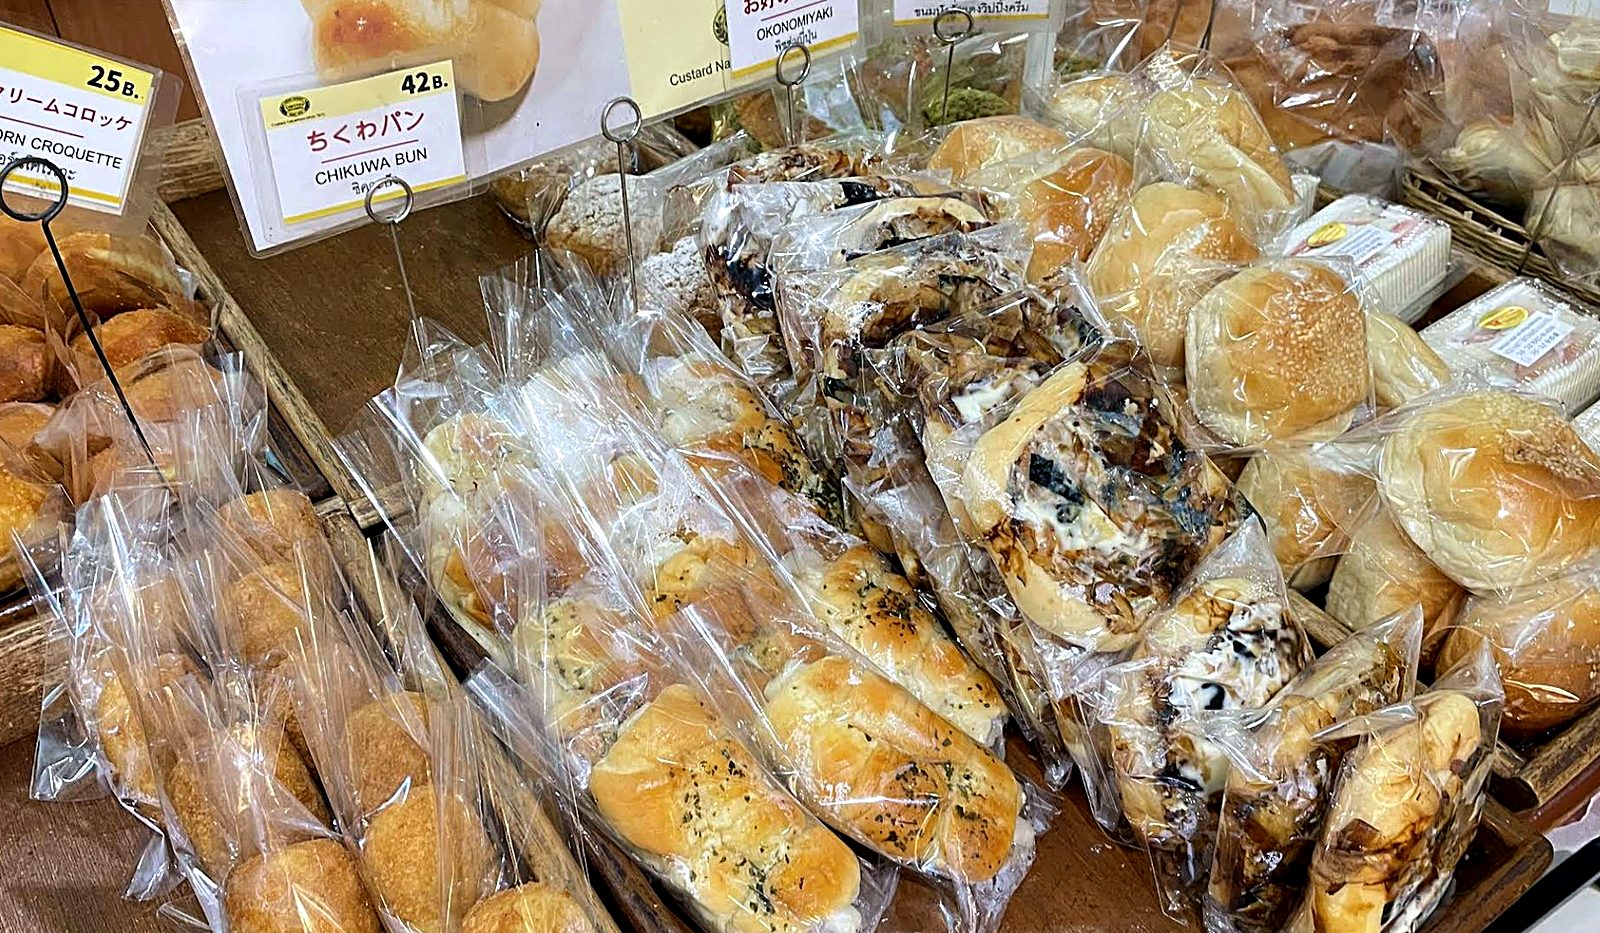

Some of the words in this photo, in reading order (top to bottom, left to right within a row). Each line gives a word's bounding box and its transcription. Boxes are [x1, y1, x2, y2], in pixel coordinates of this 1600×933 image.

[756, 6, 833, 41] OKONOMIYAKI
[669, 63, 712, 86] Custard
[0, 86, 133, 131] リームコロッケ
[307, 110, 424, 152] ちくわパン
[31, 137, 123, 169] CROQUETTE
[315, 156, 391, 186] CHIKUWA
[395, 148, 428, 166] BUN
